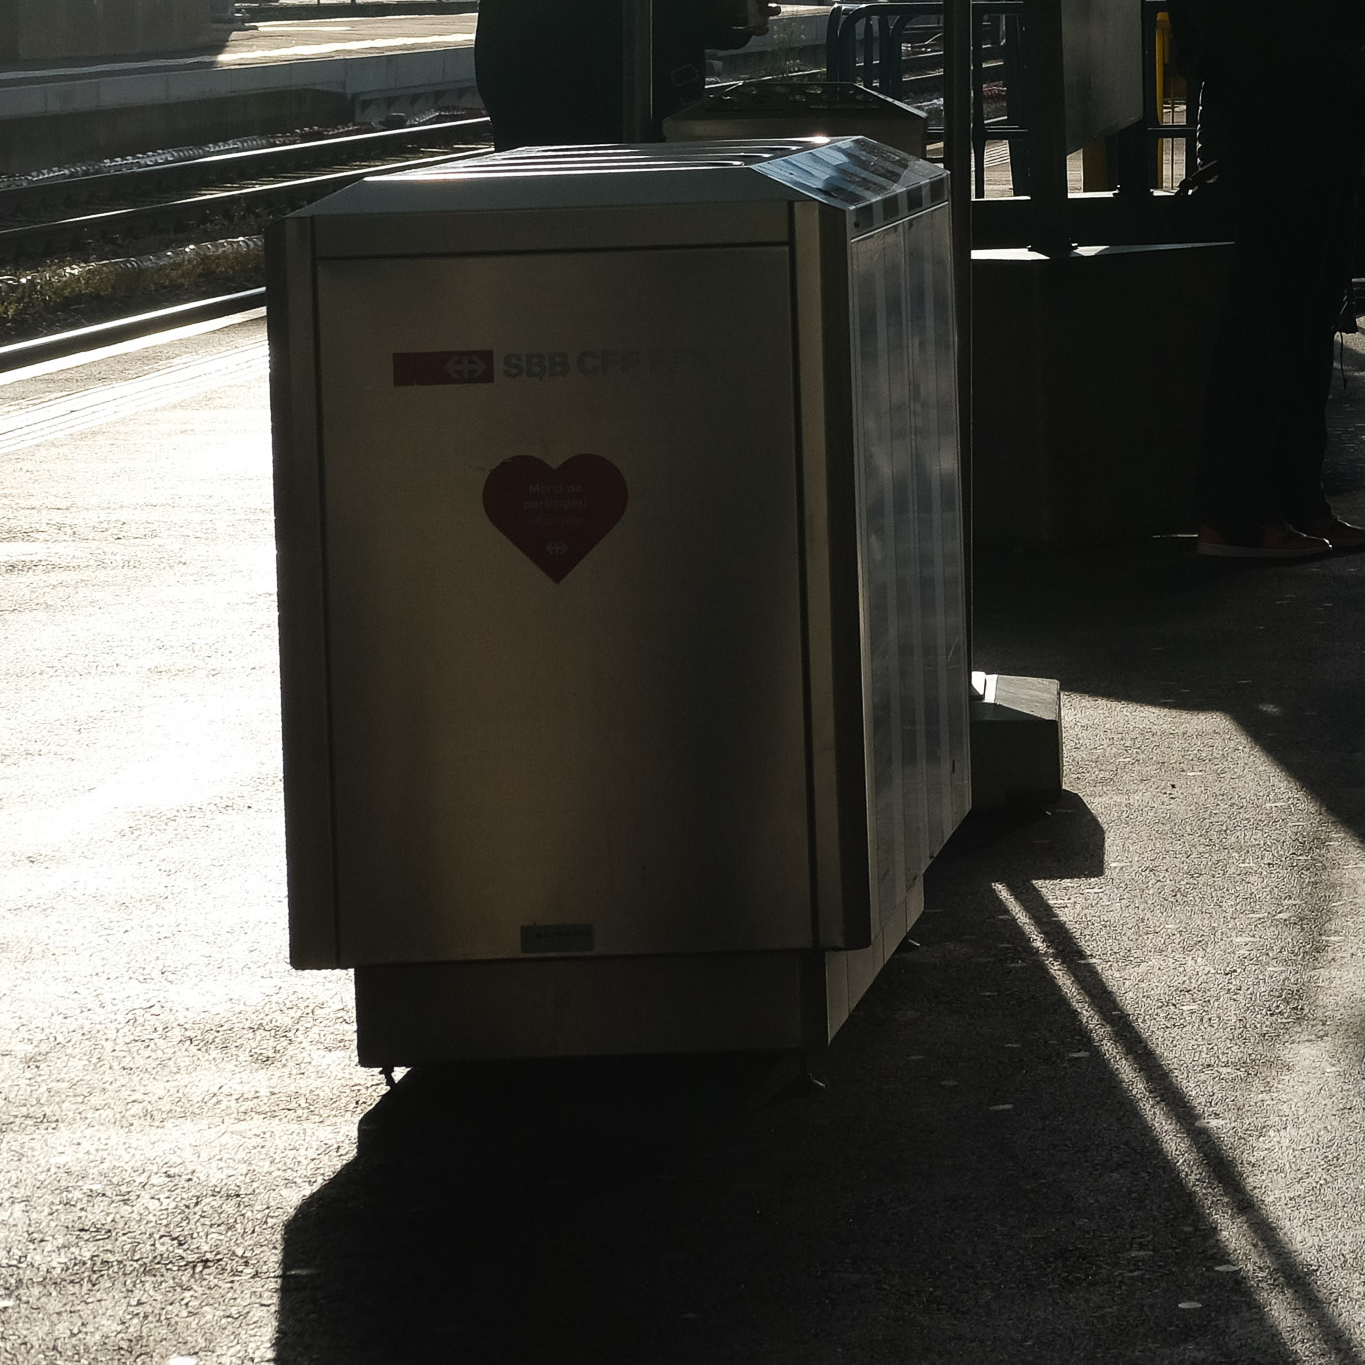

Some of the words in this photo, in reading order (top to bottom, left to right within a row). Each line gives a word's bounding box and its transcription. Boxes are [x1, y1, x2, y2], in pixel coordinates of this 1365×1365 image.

[502, 351, 571, 379] SBB
[528, 482, 564, 494] Merci
[567, 483, 583, 494] de
[523, 497, 588, 511] participer!
